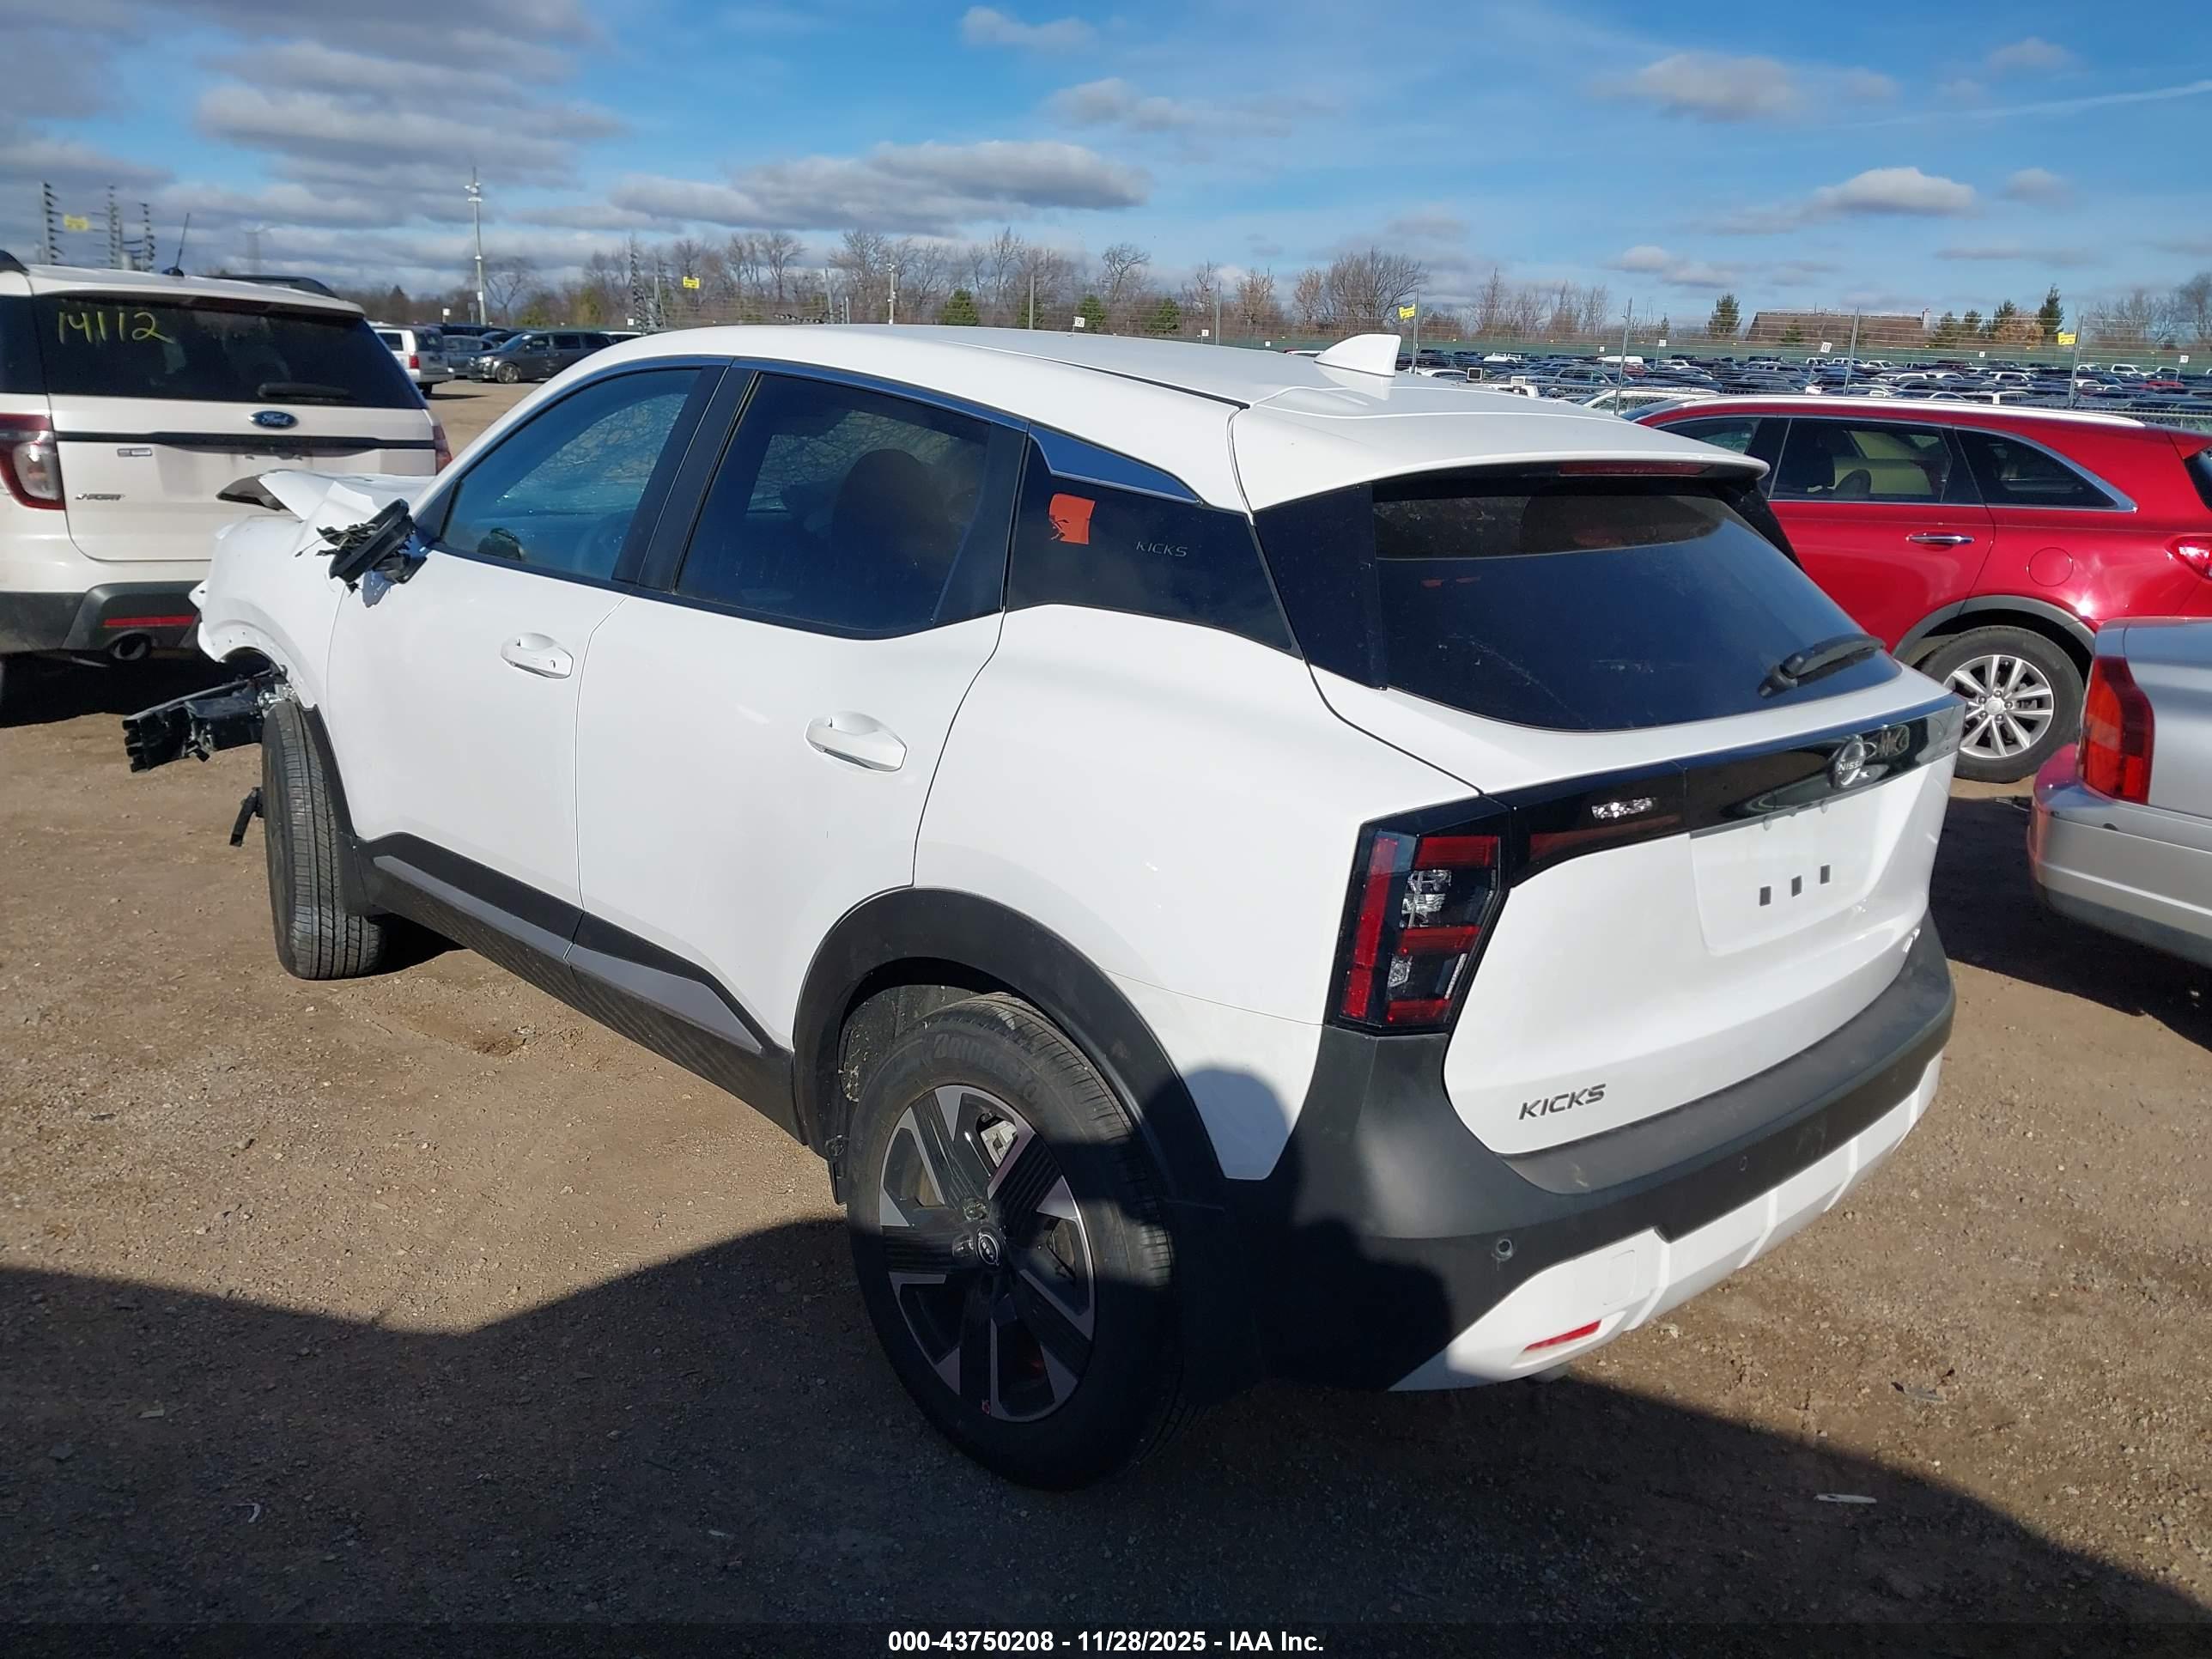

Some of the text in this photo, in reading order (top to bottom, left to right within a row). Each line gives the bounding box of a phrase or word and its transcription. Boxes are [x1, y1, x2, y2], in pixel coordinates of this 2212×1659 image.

[58, 311, 176, 344] 14112
[1136, 541, 1188, 557] KICKS
[1837, 759, 1863, 772] NISS
[1519, 1084, 1607, 1121] KICKS
